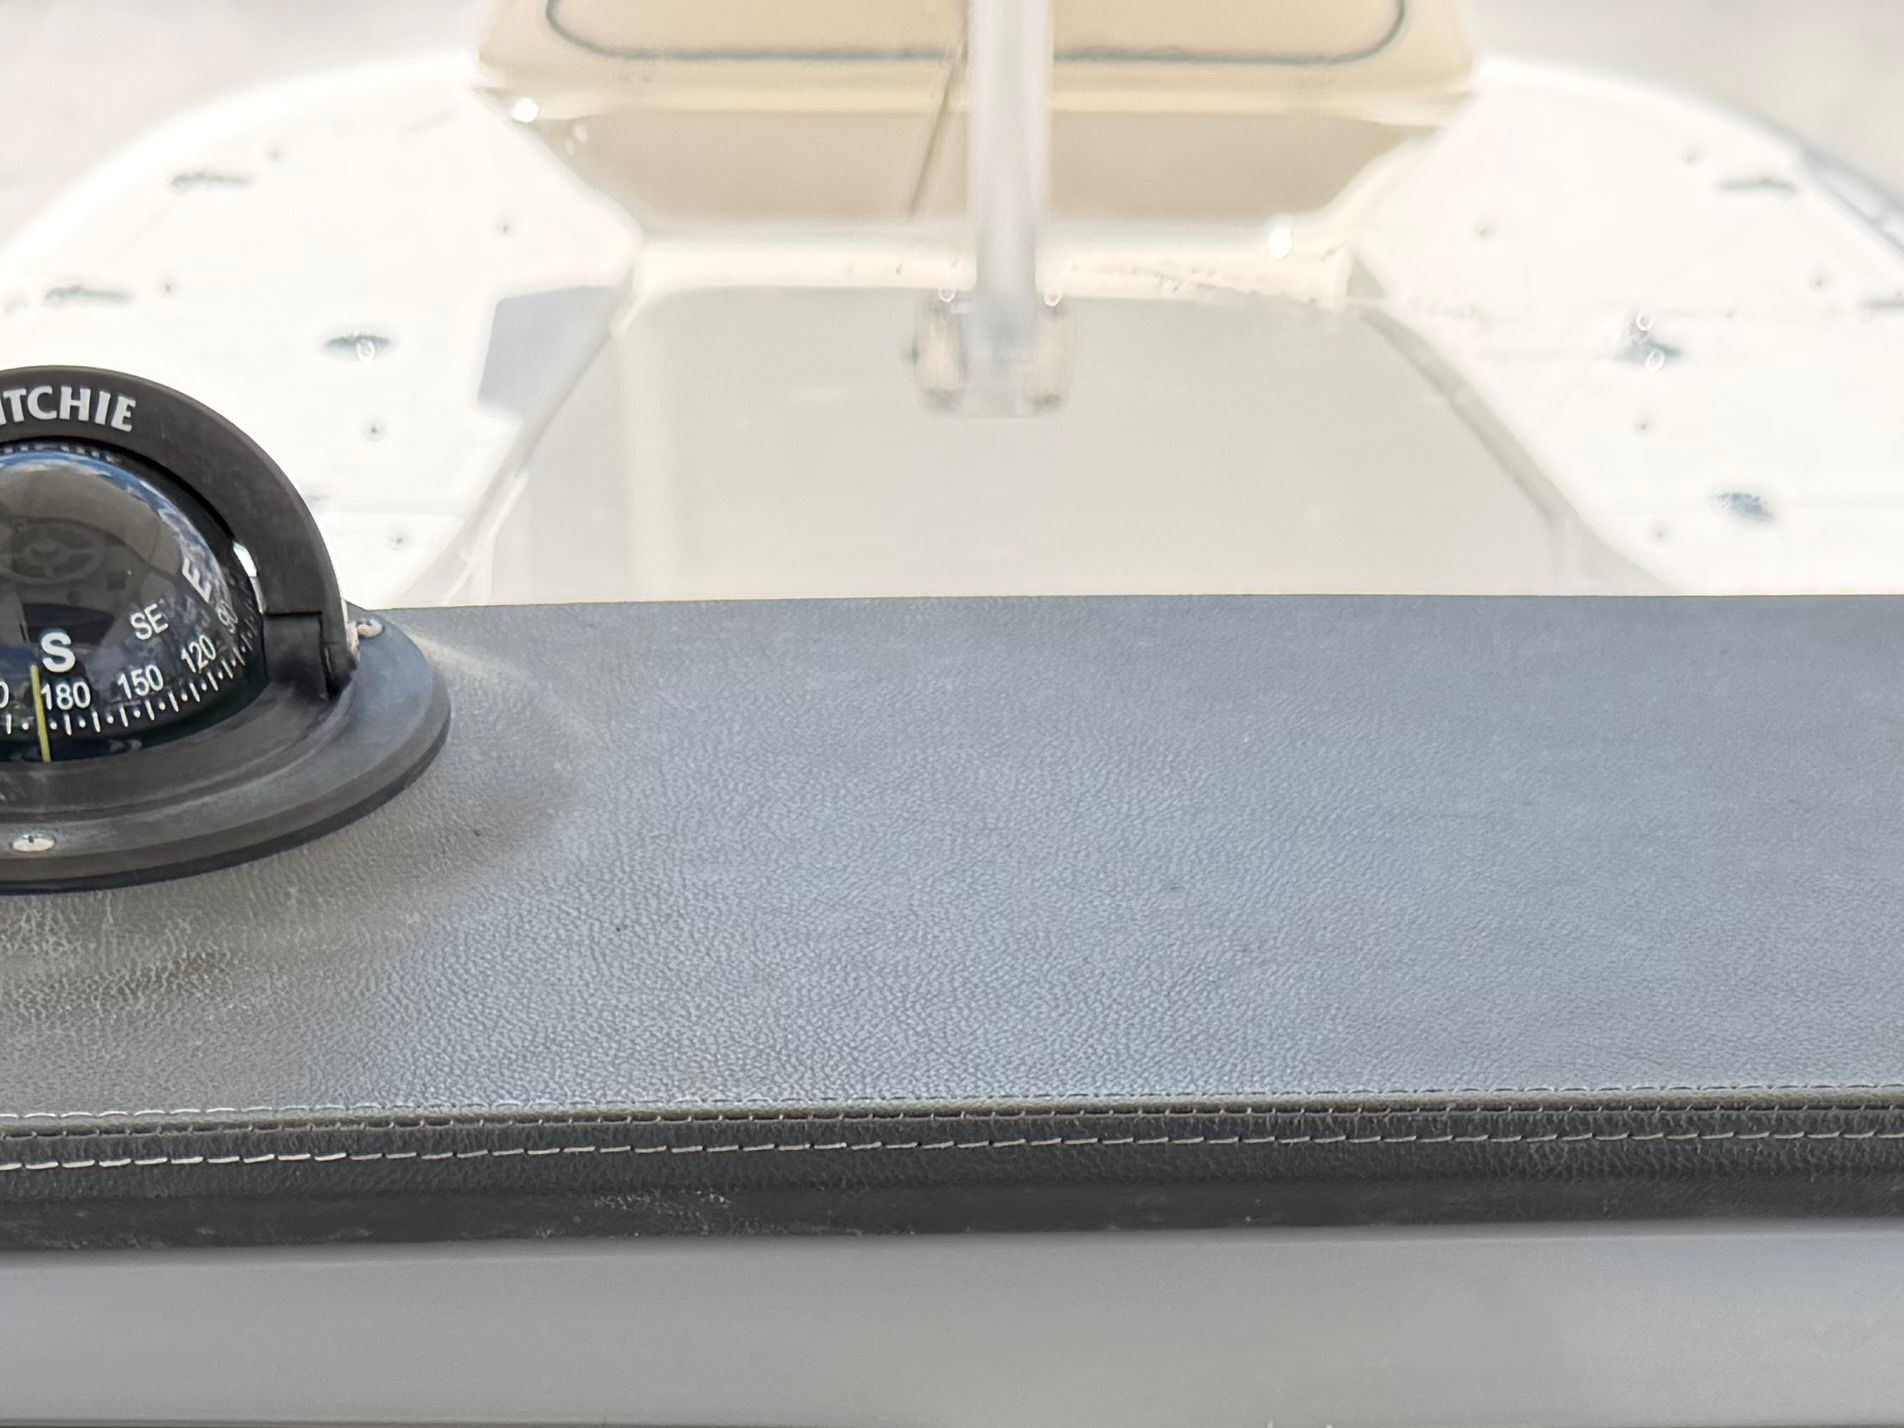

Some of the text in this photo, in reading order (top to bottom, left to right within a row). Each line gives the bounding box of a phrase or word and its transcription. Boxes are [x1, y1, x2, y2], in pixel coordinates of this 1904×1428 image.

[130, 603, 168, 641] SE
[40, 629, 77, 673] S
[41, 681, 91, 711] 180
[117, 664, 164, 699] 150
[181, 634, 216, 674] 120
